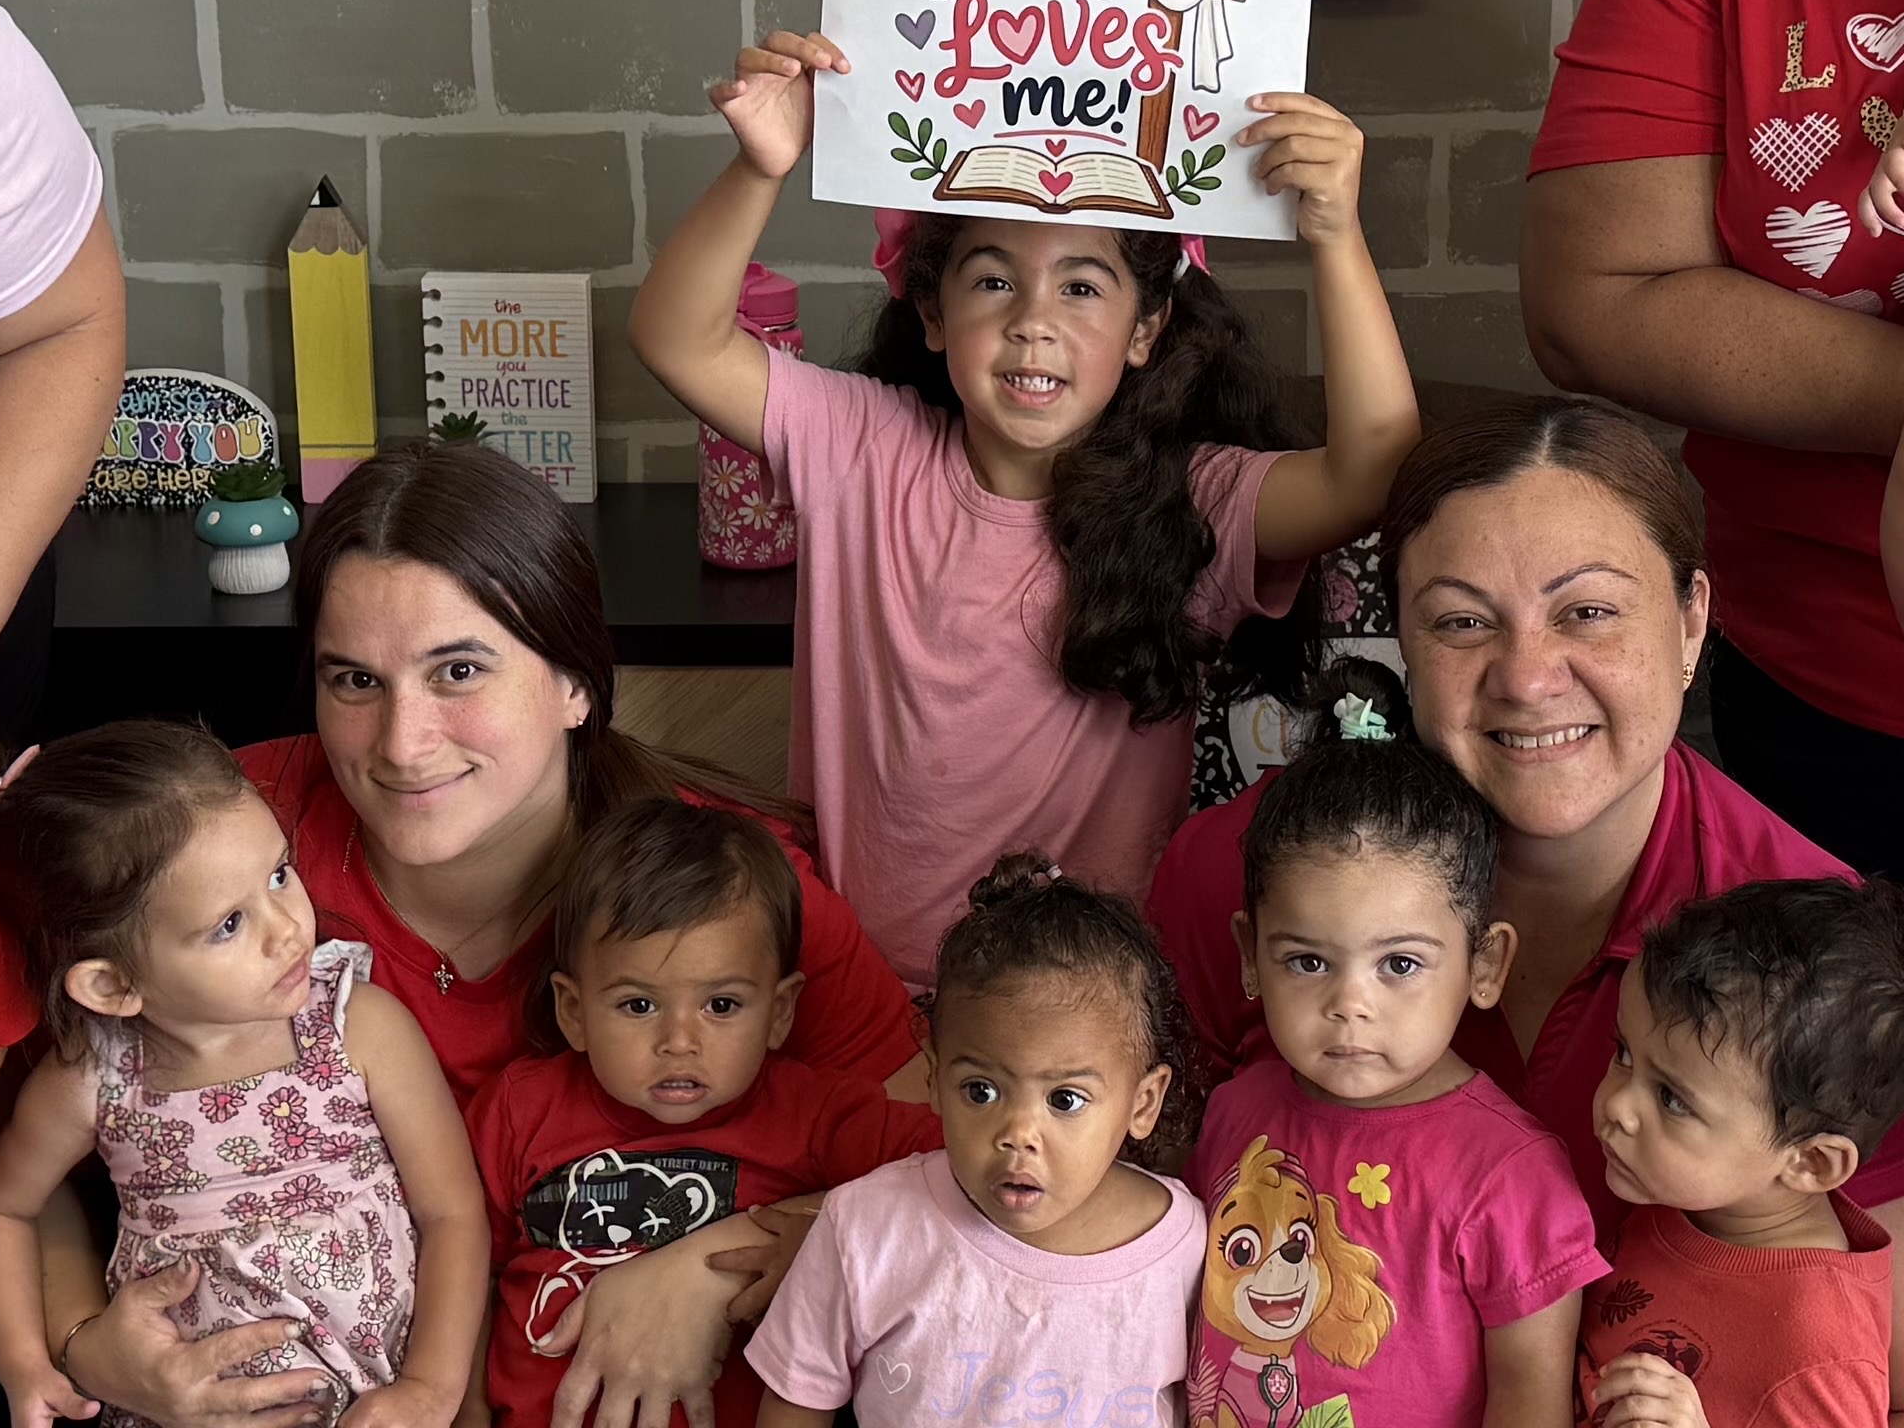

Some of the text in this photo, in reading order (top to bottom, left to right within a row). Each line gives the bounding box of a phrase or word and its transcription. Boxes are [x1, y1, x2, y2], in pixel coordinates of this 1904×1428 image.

[1002, 75, 1132, 134] me!
[494, 299, 522, 314] the
[459, 318, 569, 358] MORE
[497, 361, 527, 377] you
[461, 378, 572, 409] PRACTICE
[501, 411, 527, 425] the
[187, 414, 265, 464] YOU
[498, 430, 574, 464] TTER
[654, 1158, 697, 1169] STREET
